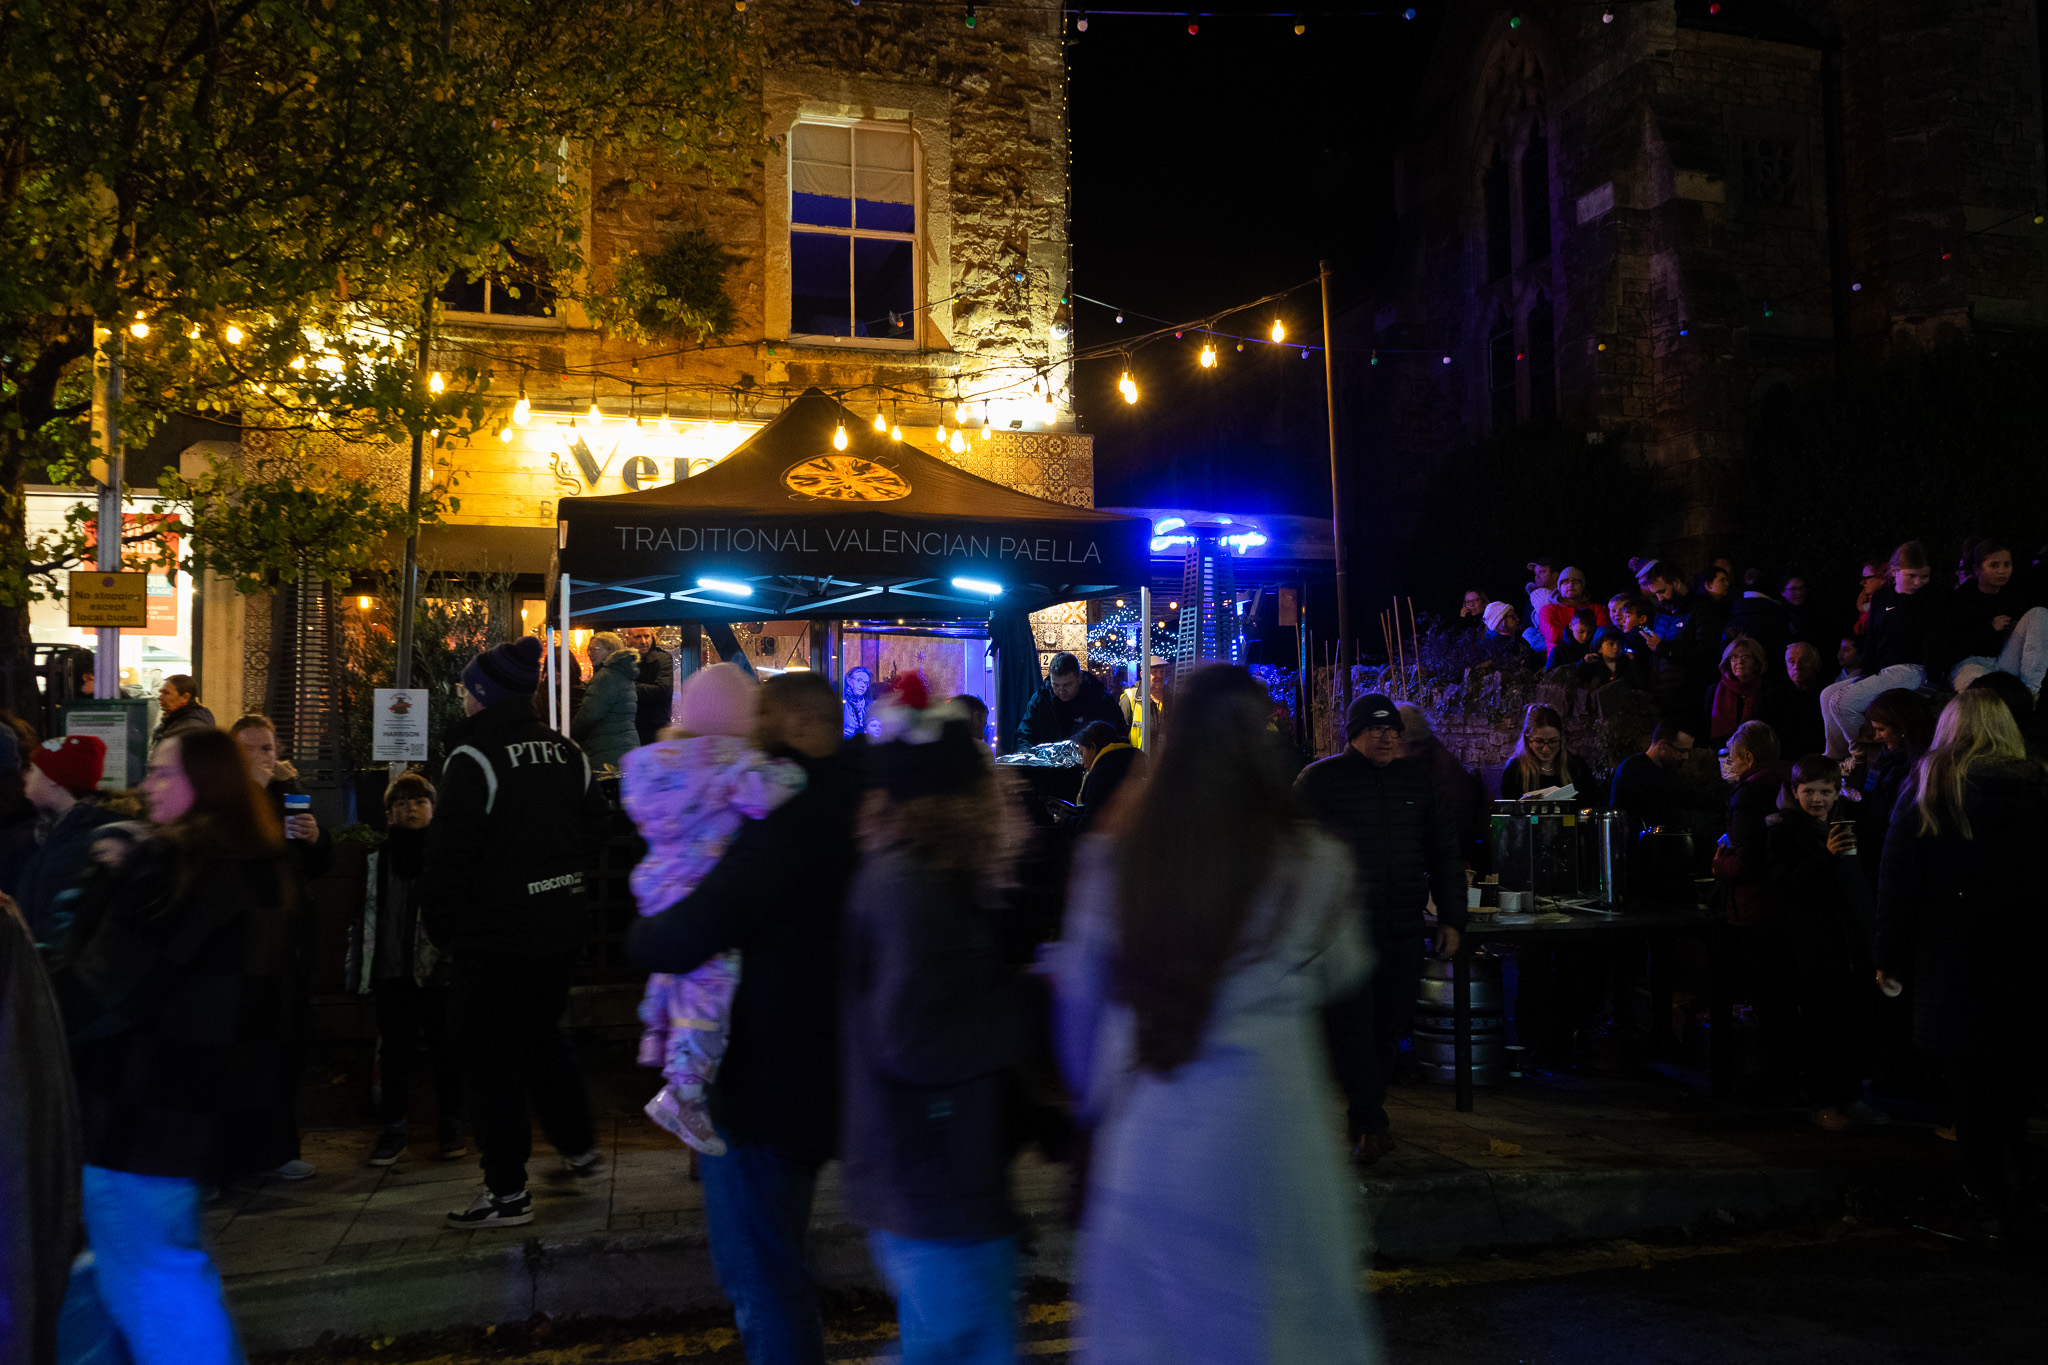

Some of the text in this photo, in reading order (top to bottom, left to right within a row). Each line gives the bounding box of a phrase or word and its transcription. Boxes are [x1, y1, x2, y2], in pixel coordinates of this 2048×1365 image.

[614, 526, 1102, 564] TRADITIONAL VALENCIAN PAELLA
[75, 591, 90, 599] No
[94, 591, 142, 601] stopping
[90, 603, 127, 611] except
[77, 612, 103, 621] local
[107, 612, 138, 621] buses
[504, 740, 568, 768] PTFC
[527, 873, 575, 895] macron
